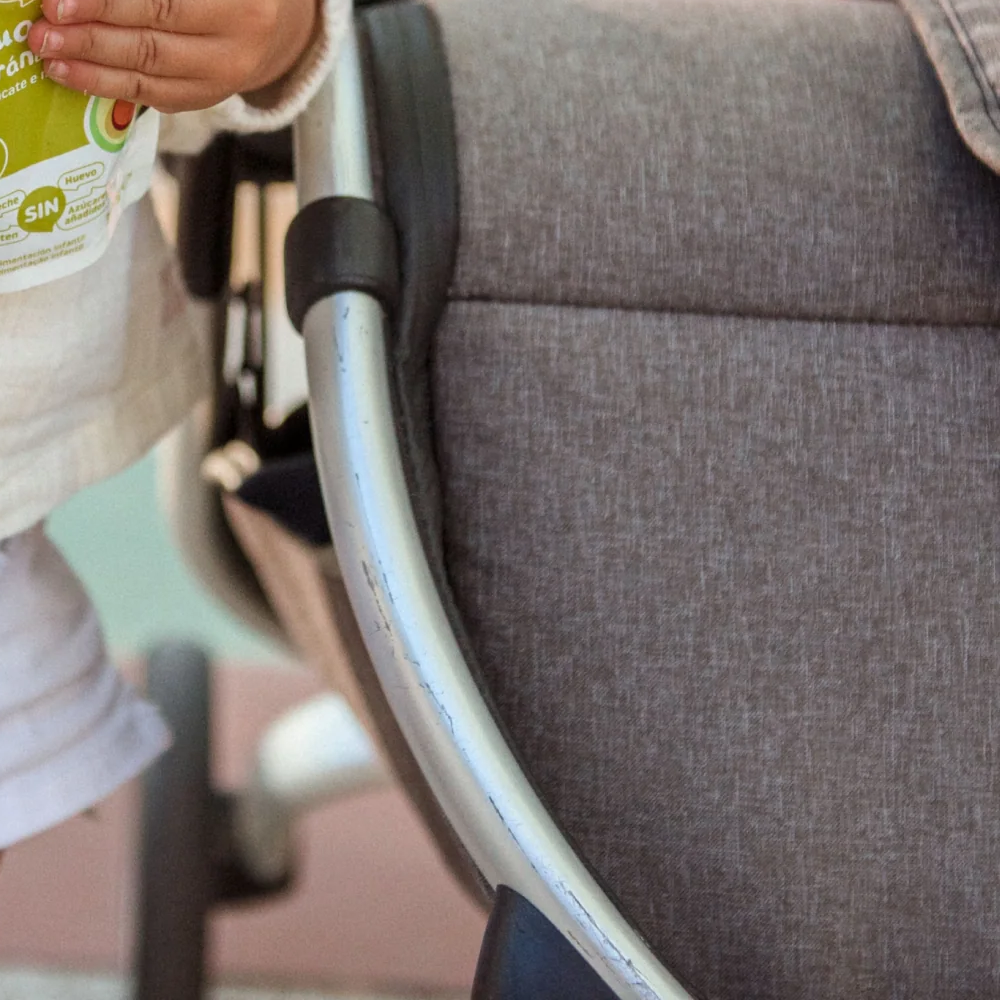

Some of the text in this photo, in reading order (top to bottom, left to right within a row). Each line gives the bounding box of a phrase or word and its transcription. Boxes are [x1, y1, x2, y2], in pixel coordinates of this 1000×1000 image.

[30, 74, 38, 85] e
[64, 168, 98, 185] Huevo
[23, 196, 60, 224] SIN
